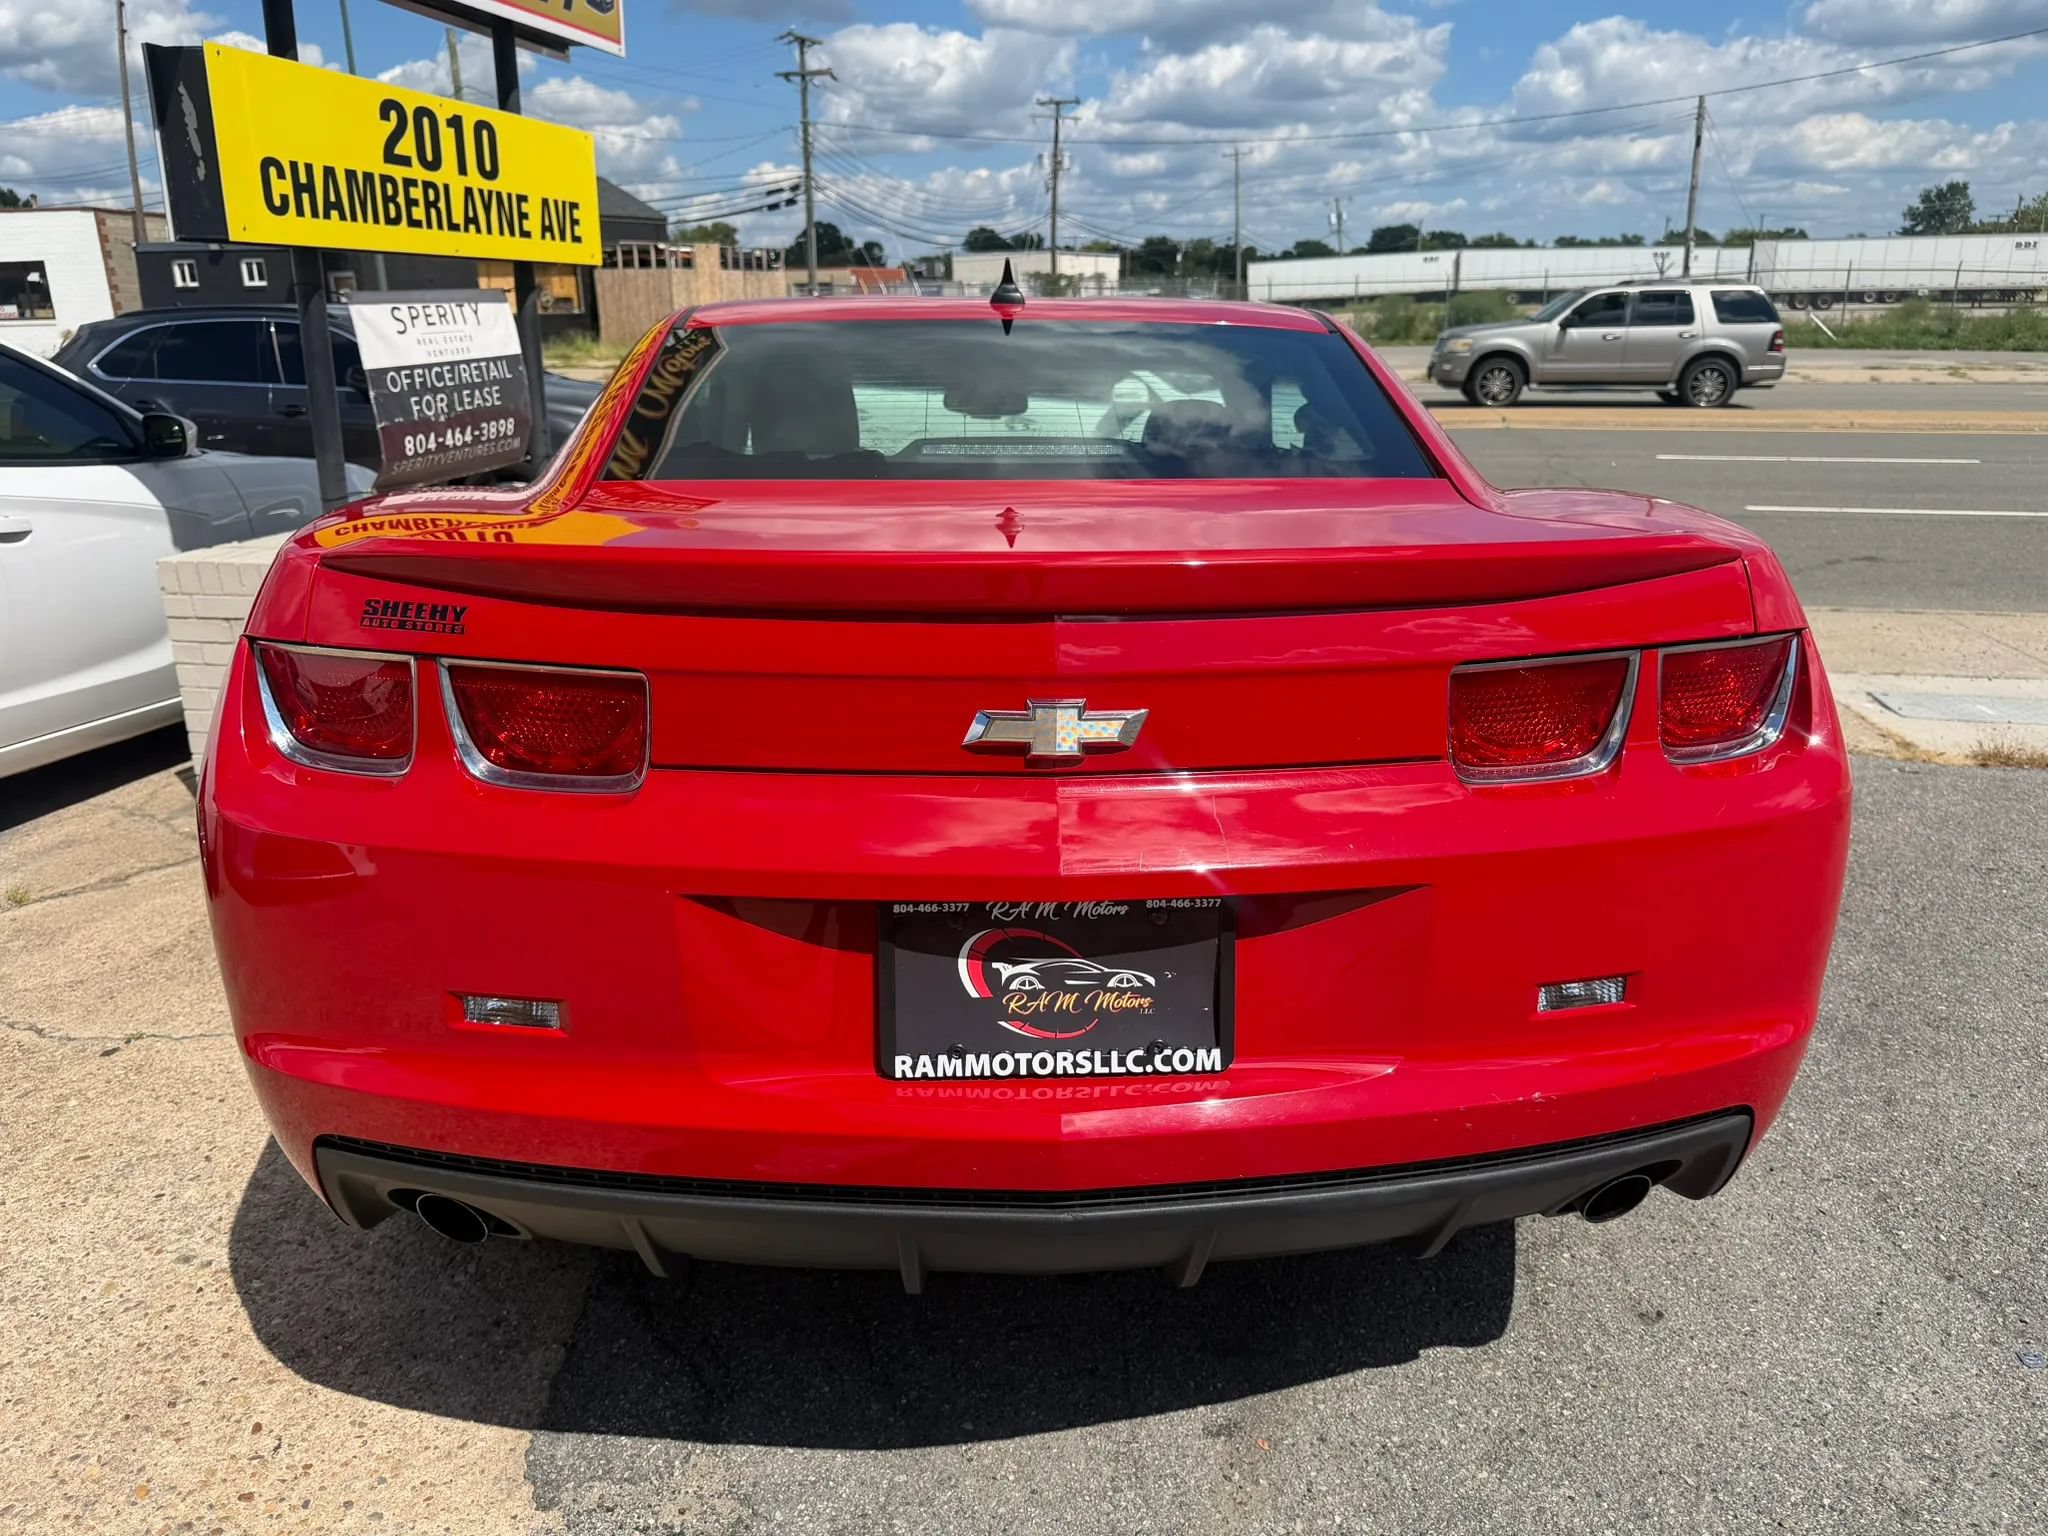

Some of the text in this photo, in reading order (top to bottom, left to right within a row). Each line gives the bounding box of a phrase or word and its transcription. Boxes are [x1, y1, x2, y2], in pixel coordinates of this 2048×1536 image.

[379, 98, 499, 181] 2010
[259, 156, 582, 244] CHAMBERLAYNE AVE
[390, 303, 481, 335] SPERITY
[417, 334, 473, 346] REAL ESTATE
[426, 347, 471, 358] VENTURES
[386, 359, 513, 393] OFFICE/RETAIL
[410, 386, 502, 420] FOR LEASE
[404, 417, 515, 456] 804-464-3898
[391, 436, 521, 475] SPERITYVENTURES.COM
[363, 598, 469, 623] SHEEHY
[362, 618, 464, 633] AUTO STORES
[893, 902, 969, 913] 804-466-3377
[985, 900, 1130, 921] RAM Motors
[1146, 899, 1221, 909] 804-466-3377
[1002, 989, 1155, 1015] RAM Motors
[894, 1048, 1222, 1078] RAMMOTORSLLC.COM
